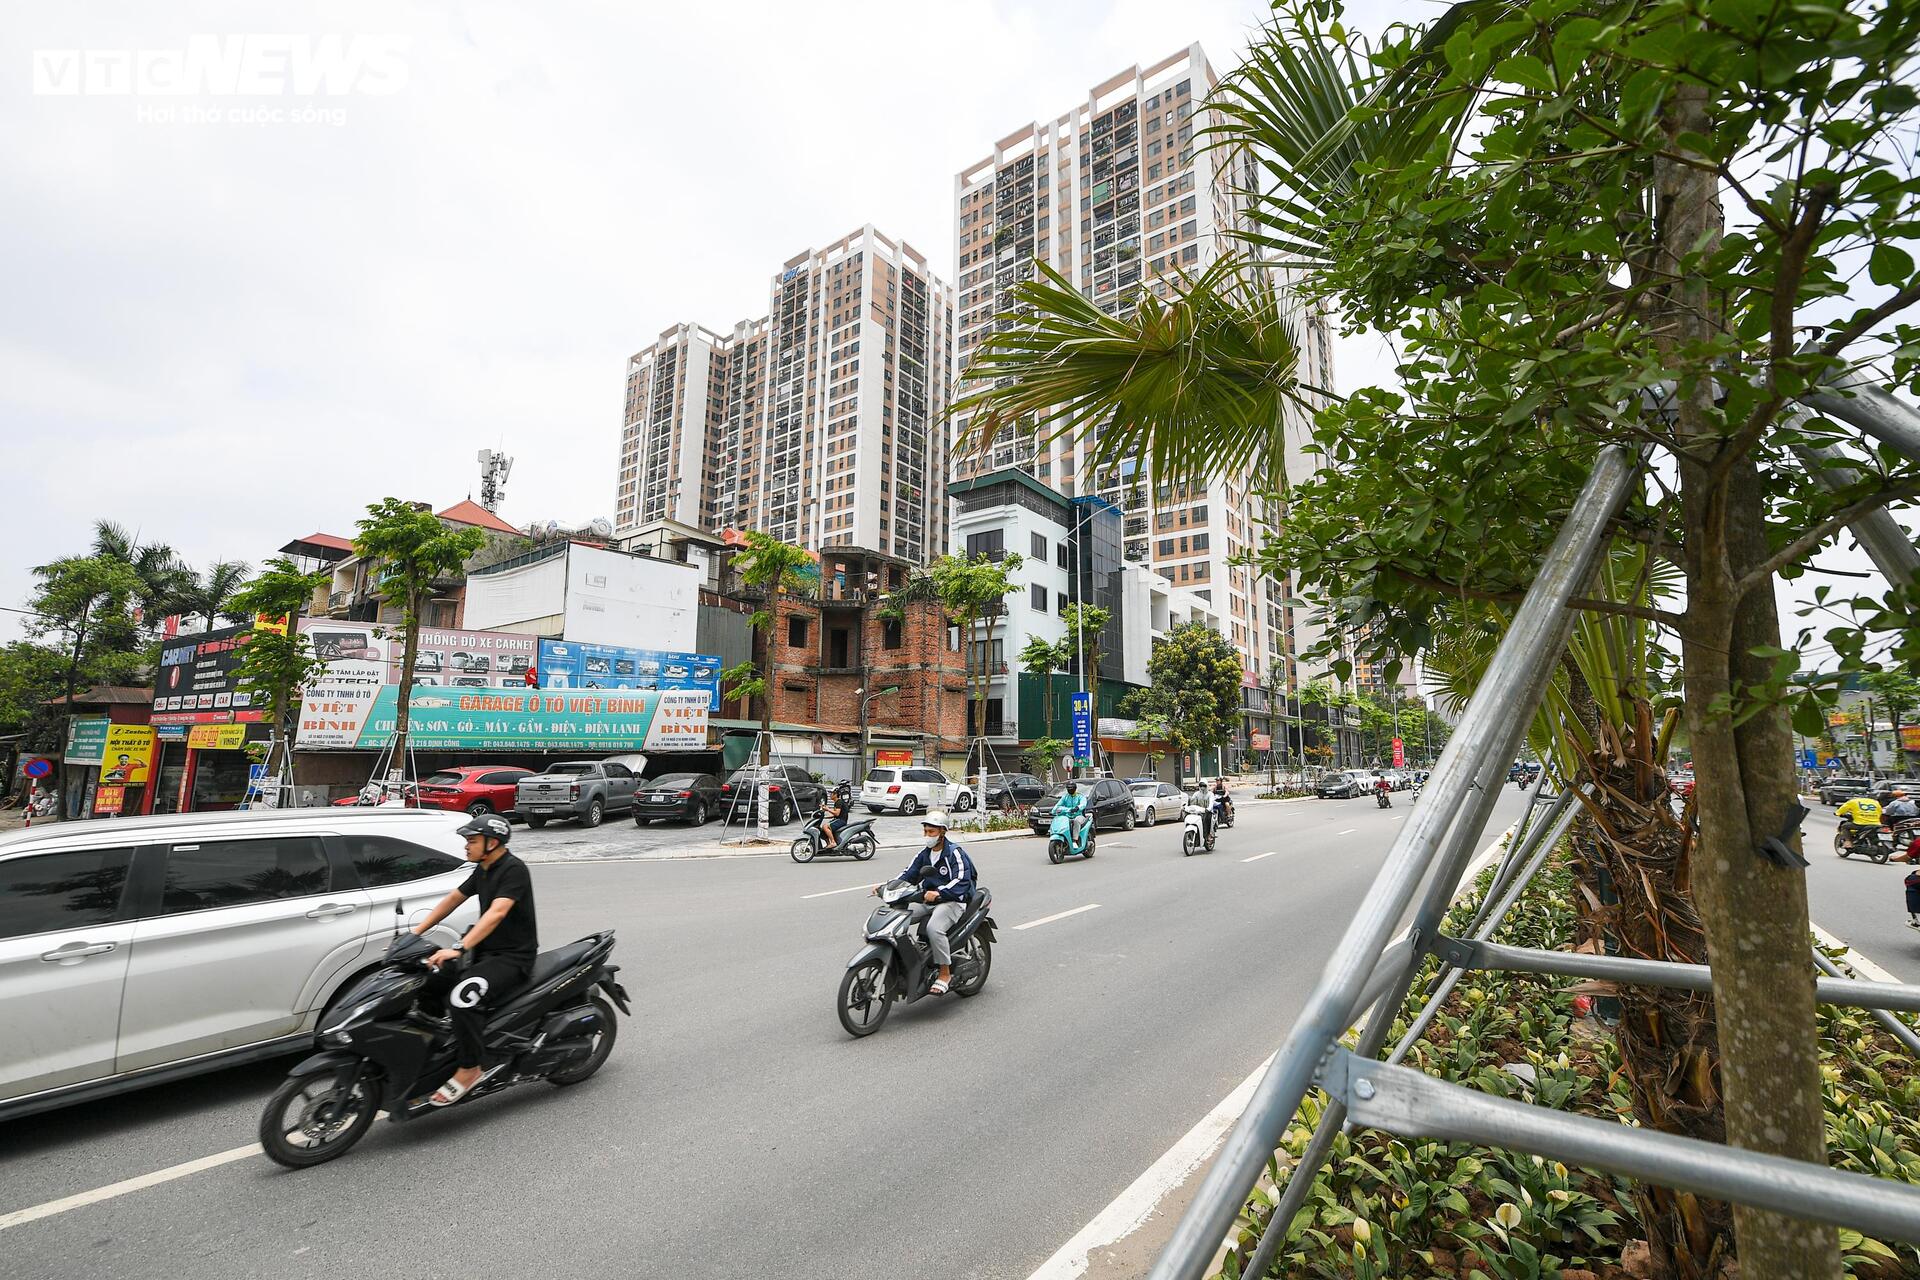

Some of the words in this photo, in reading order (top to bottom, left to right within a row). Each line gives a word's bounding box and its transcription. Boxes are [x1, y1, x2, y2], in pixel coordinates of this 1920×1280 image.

[258, 612, 287, 625] RA
[419, 632, 457, 646] THỐNG
[461, 634, 476, 649] ĐỘ
[480, 637, 494, 648] XE
[496, 638, 534, 651] CARNET
[306, 688, 325, 698] CÔNG
[327, 690, 335, 698] TY
[336, 690, 355, 698] TNHH
[308, 701, 358, 715] VIỆT
[460, 695, 524, 712] GARAGE
[529, 694, 541, 713] Ô
[545, 695, 564, 713] TÔ
[569, 695, 603, 716] VIỆT
[607, 696, 646, 714] BÌNH
[664, 706, 706, 720] VIỆT
[303, 717, 357, 731] BÌNH
[426, 719, 449, 732] SƠN
[485, 719, 510, 733] MÁY
[551, 720, 576, 737] ĐIỆN
[585, 720, 610, 737] ĐIỆN
[612, 723, 640, 738] LẠNH
[661, 722, 705, 734] BÌNH
[1858, 801, 1877, 811] be
[450, 976, 489, 1008] G
